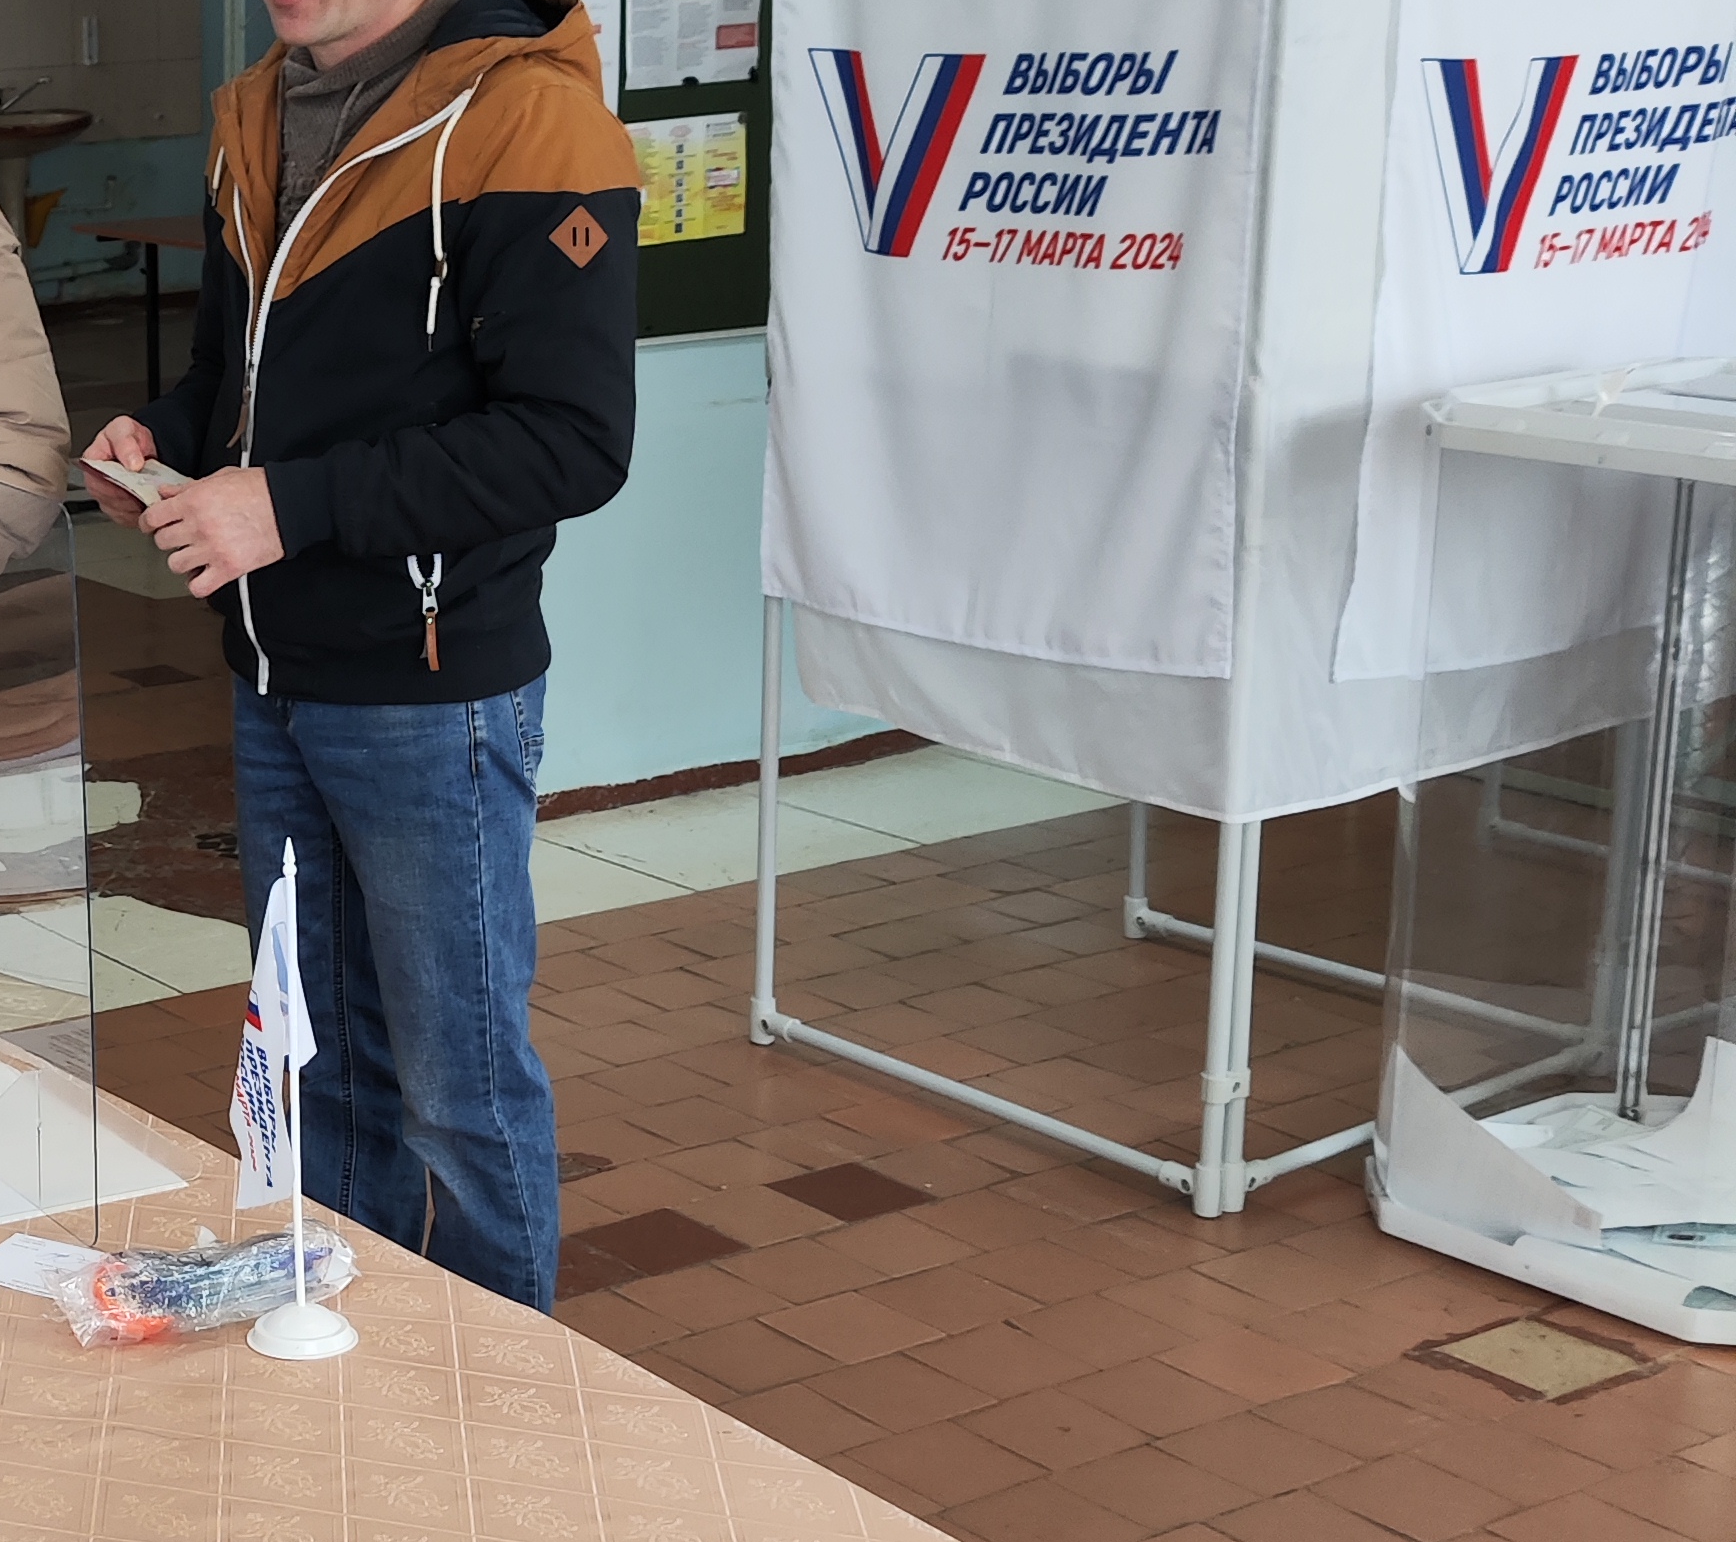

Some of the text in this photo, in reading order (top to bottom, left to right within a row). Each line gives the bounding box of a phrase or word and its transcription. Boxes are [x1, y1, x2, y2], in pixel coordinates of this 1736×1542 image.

[1002, 49, 1179, 96] ВЫБОРЫ
[1588, 41, 1734, 96] ВЫБОРЫ
[979, 109, 1222, 164] ПРЕЗИДЕНТА
[958, 171, 1109, 217] РОССИИ
[1547, 163, 1681, 217] РОССИИ
[1016, 228, 1106, 269] МАРТА
[1109, 232, 1184, 270] 2024
[1592, 219, 1677, 262] МАРТА
